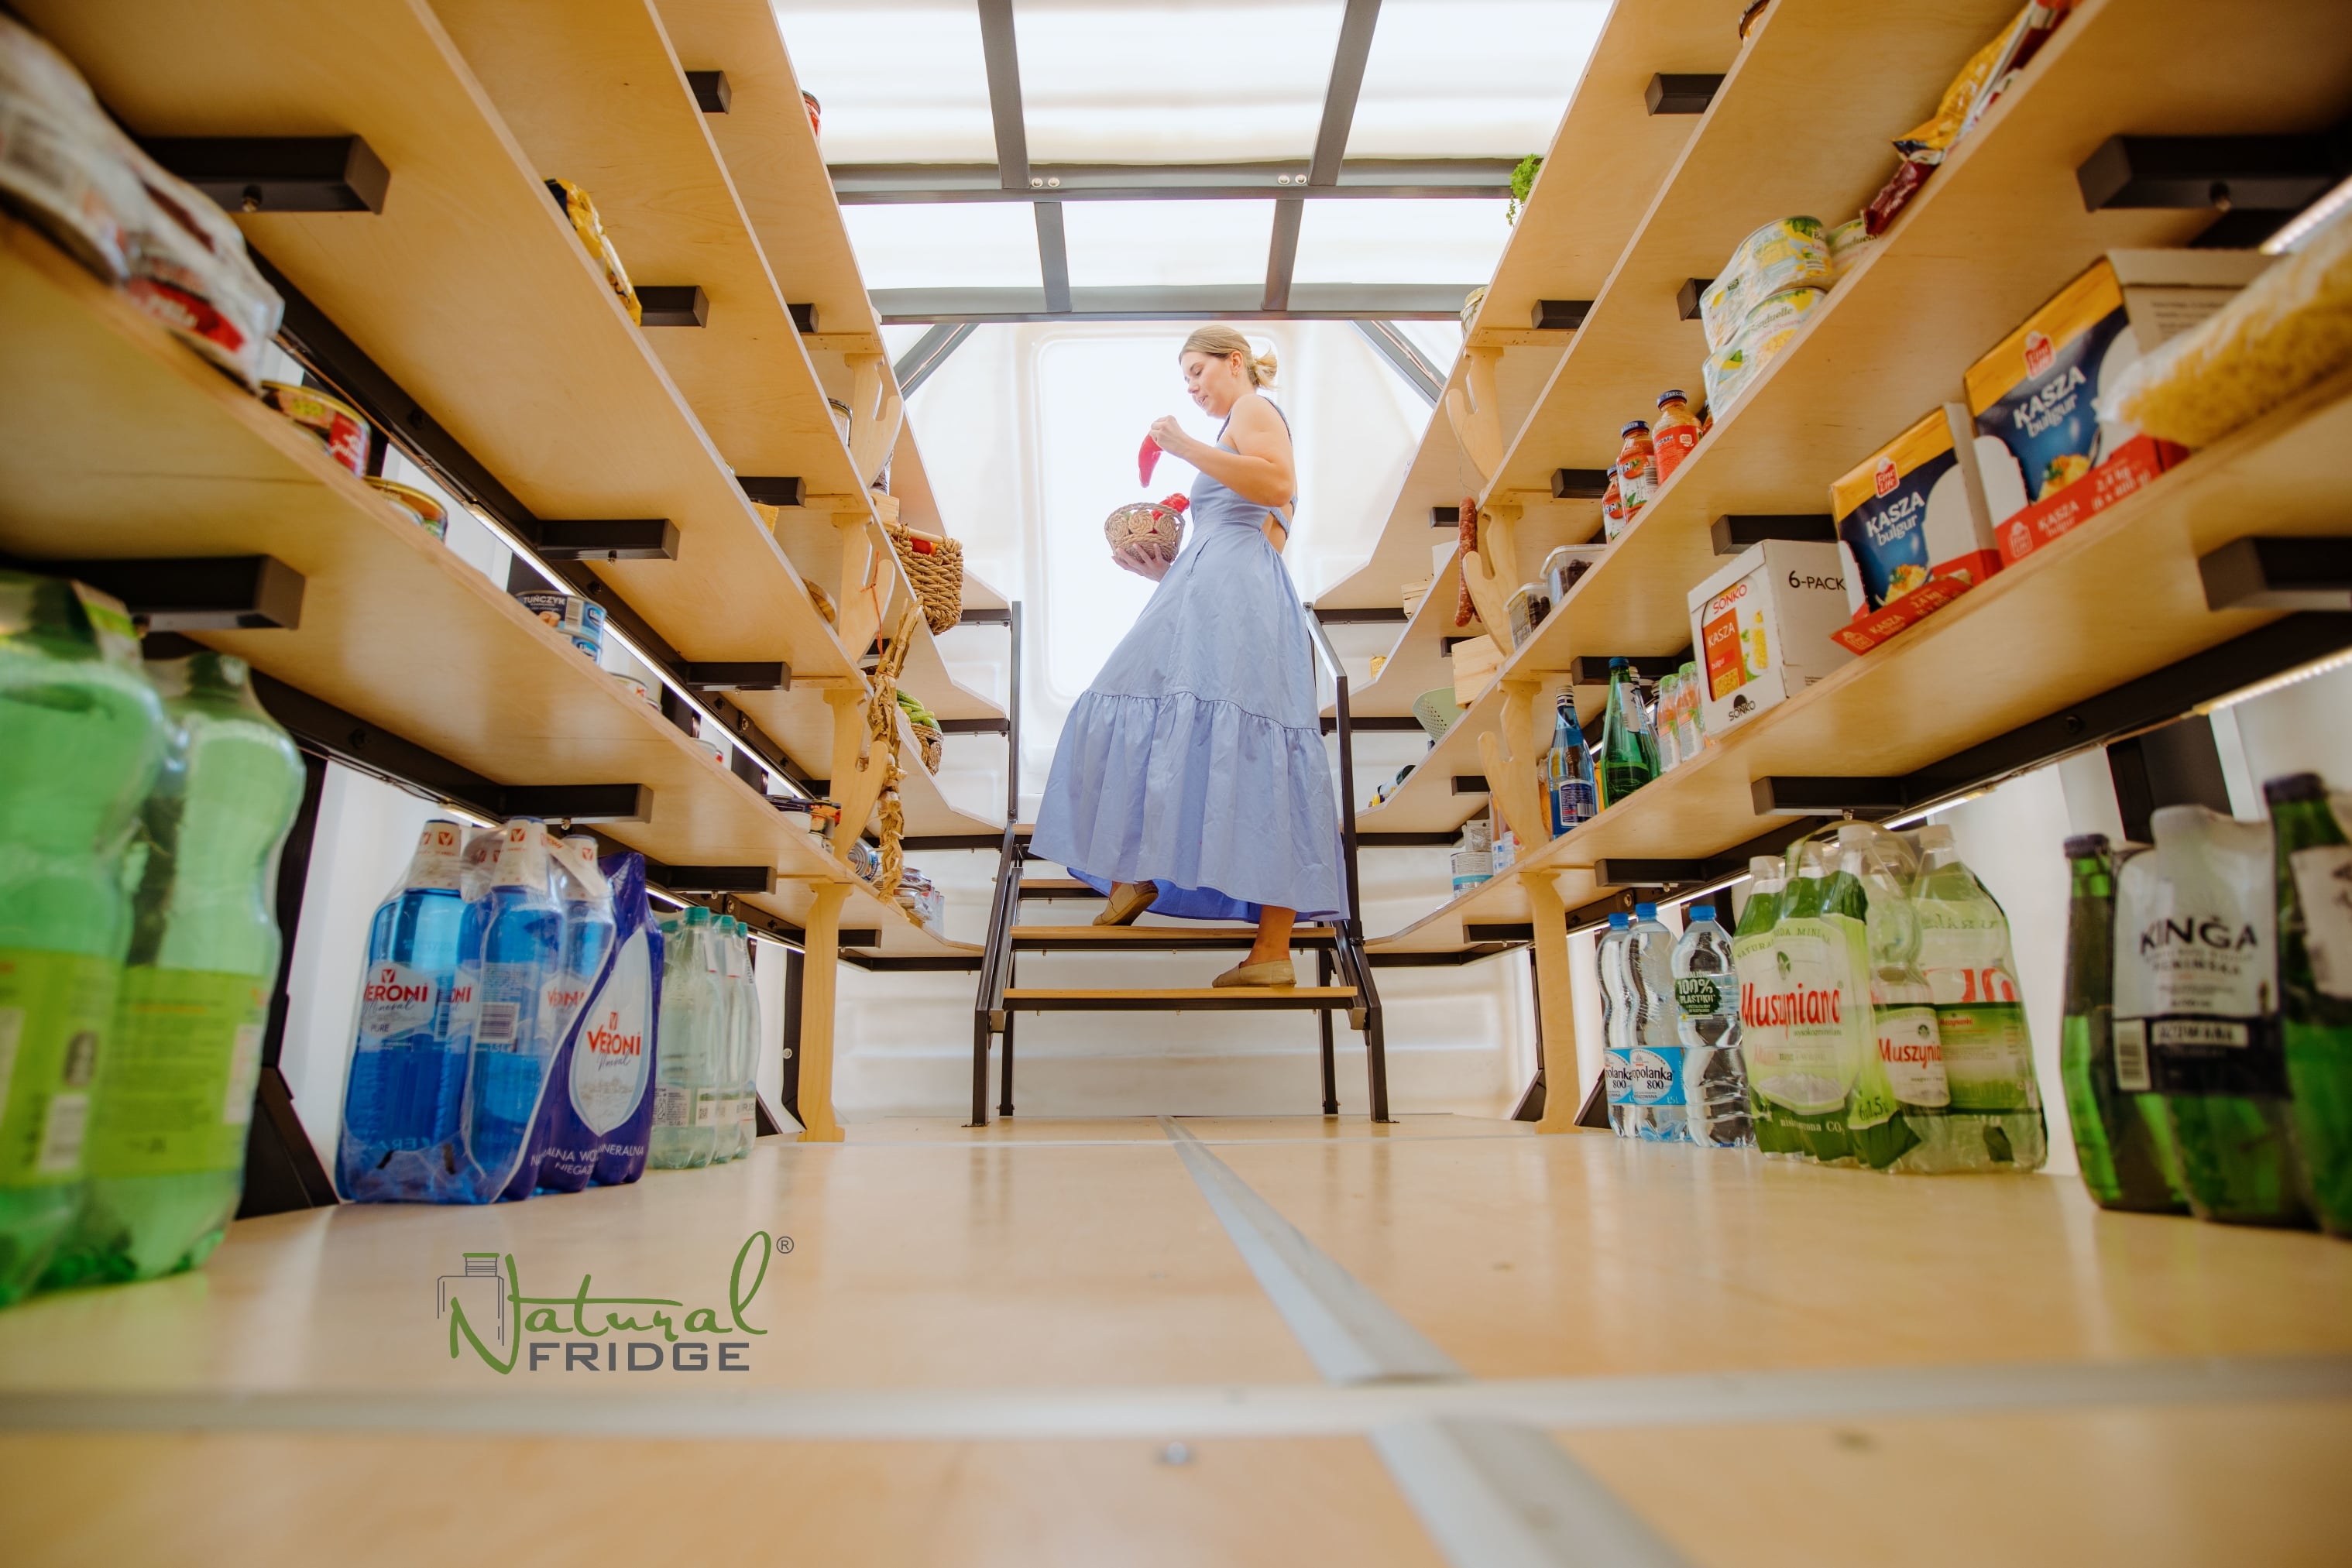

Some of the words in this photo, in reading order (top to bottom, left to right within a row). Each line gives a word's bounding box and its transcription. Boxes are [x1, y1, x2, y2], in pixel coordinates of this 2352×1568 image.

[2014, 365, 2087, 429] KASZA
[2028, 393, 2079, 438] bulgur
[1866, 491, 1926, 538] KASZA
[2038, 500, 2081, 531] KASZA
[1876, 513, 1918, 547] bulgur
[1788, 570, 1847, 591] 6-PACK
[523, 595, 566, 606] TUŃCZYK
[1712, 584, 1748, 614] SONKO
[1708, 622, 1736, 649] KASZA
[1729, 700, 1756, 722] SONKO
[1678, 978, 1713, 995] 100%
[1613, 1079, 1626, 1089] 800
[1646, 1079, 1664, 1090] 800
